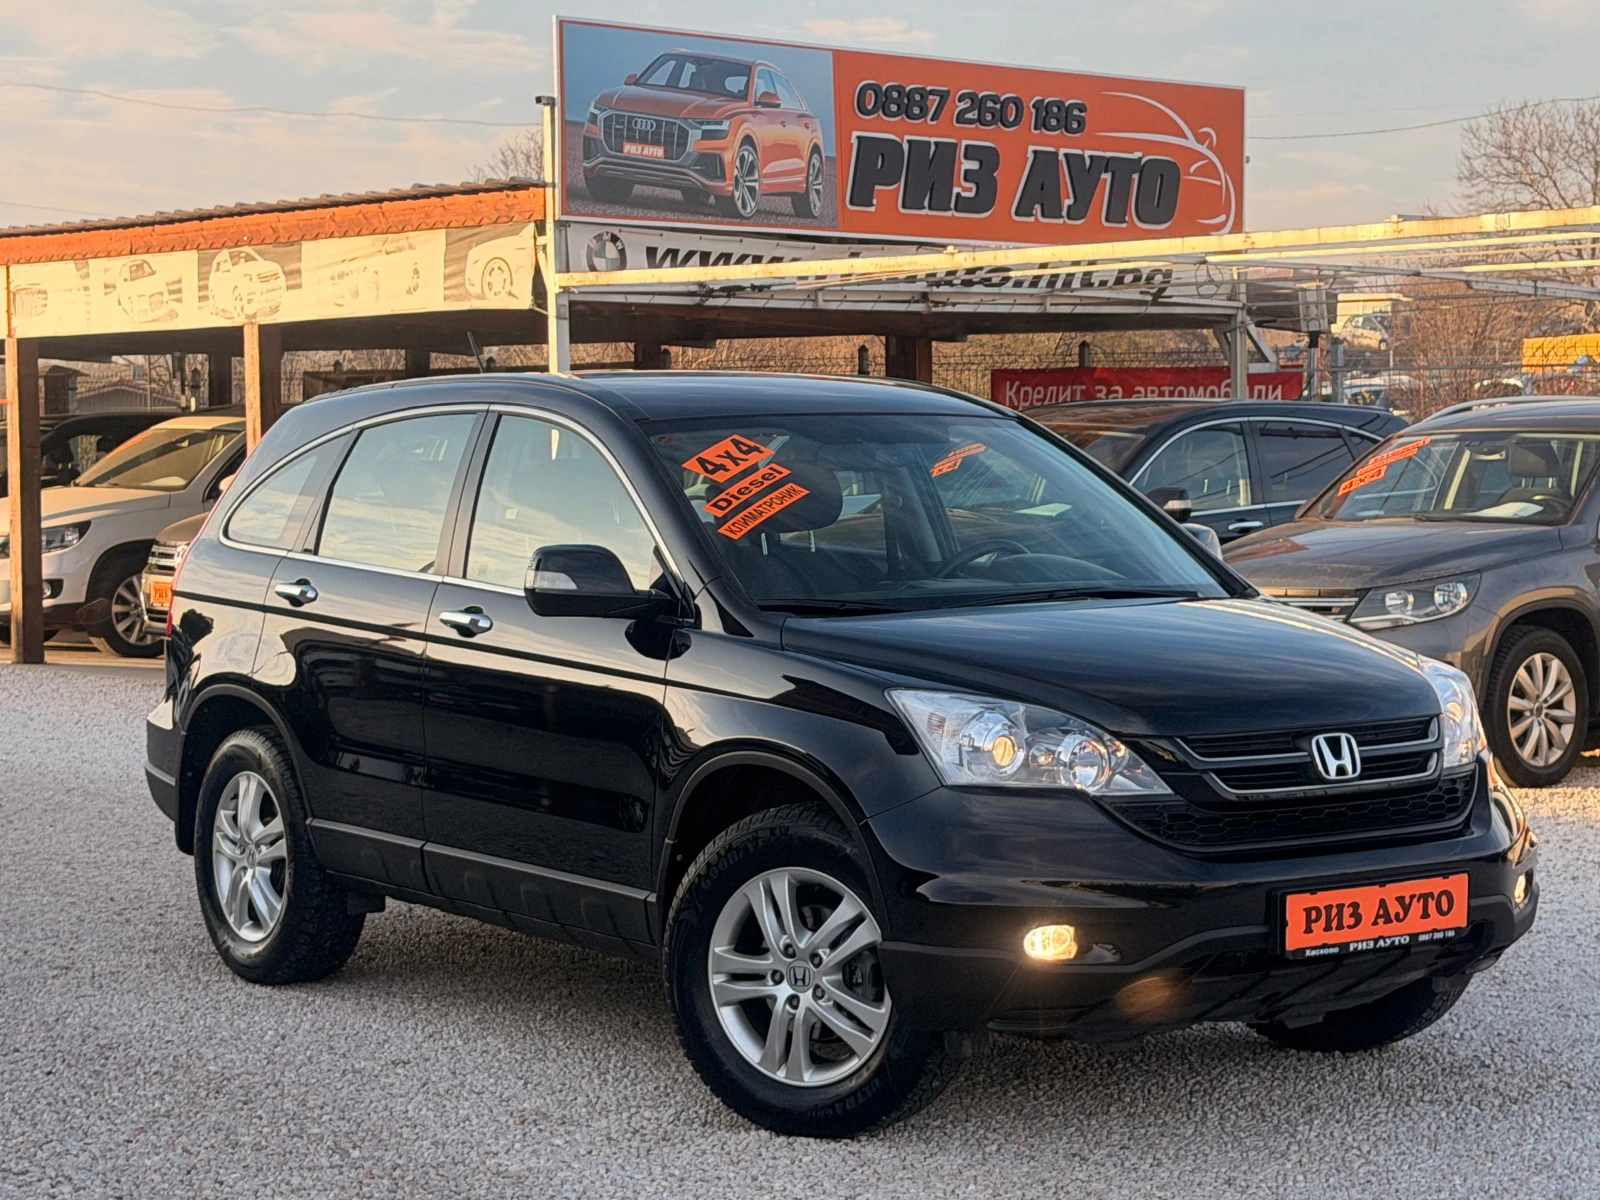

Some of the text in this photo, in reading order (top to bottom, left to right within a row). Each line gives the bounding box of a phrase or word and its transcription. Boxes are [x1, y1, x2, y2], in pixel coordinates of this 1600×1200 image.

[854, 79, 1089, 136] 0887 260 186
[846, 131, 1182, 229] РИЗ АУТО
[1004, 377, 1283, 411] Кредит за автомобли
[711, 466, 784, 512] Diesel
[724, 485, 804, 536] КЛИМАТРОНИК
[1302, 889, 1455, 935] РИЗ АУТО
[1349, 940, 1375, 952] РИЗ
[1376, 935, 1410, 948] АУТО
